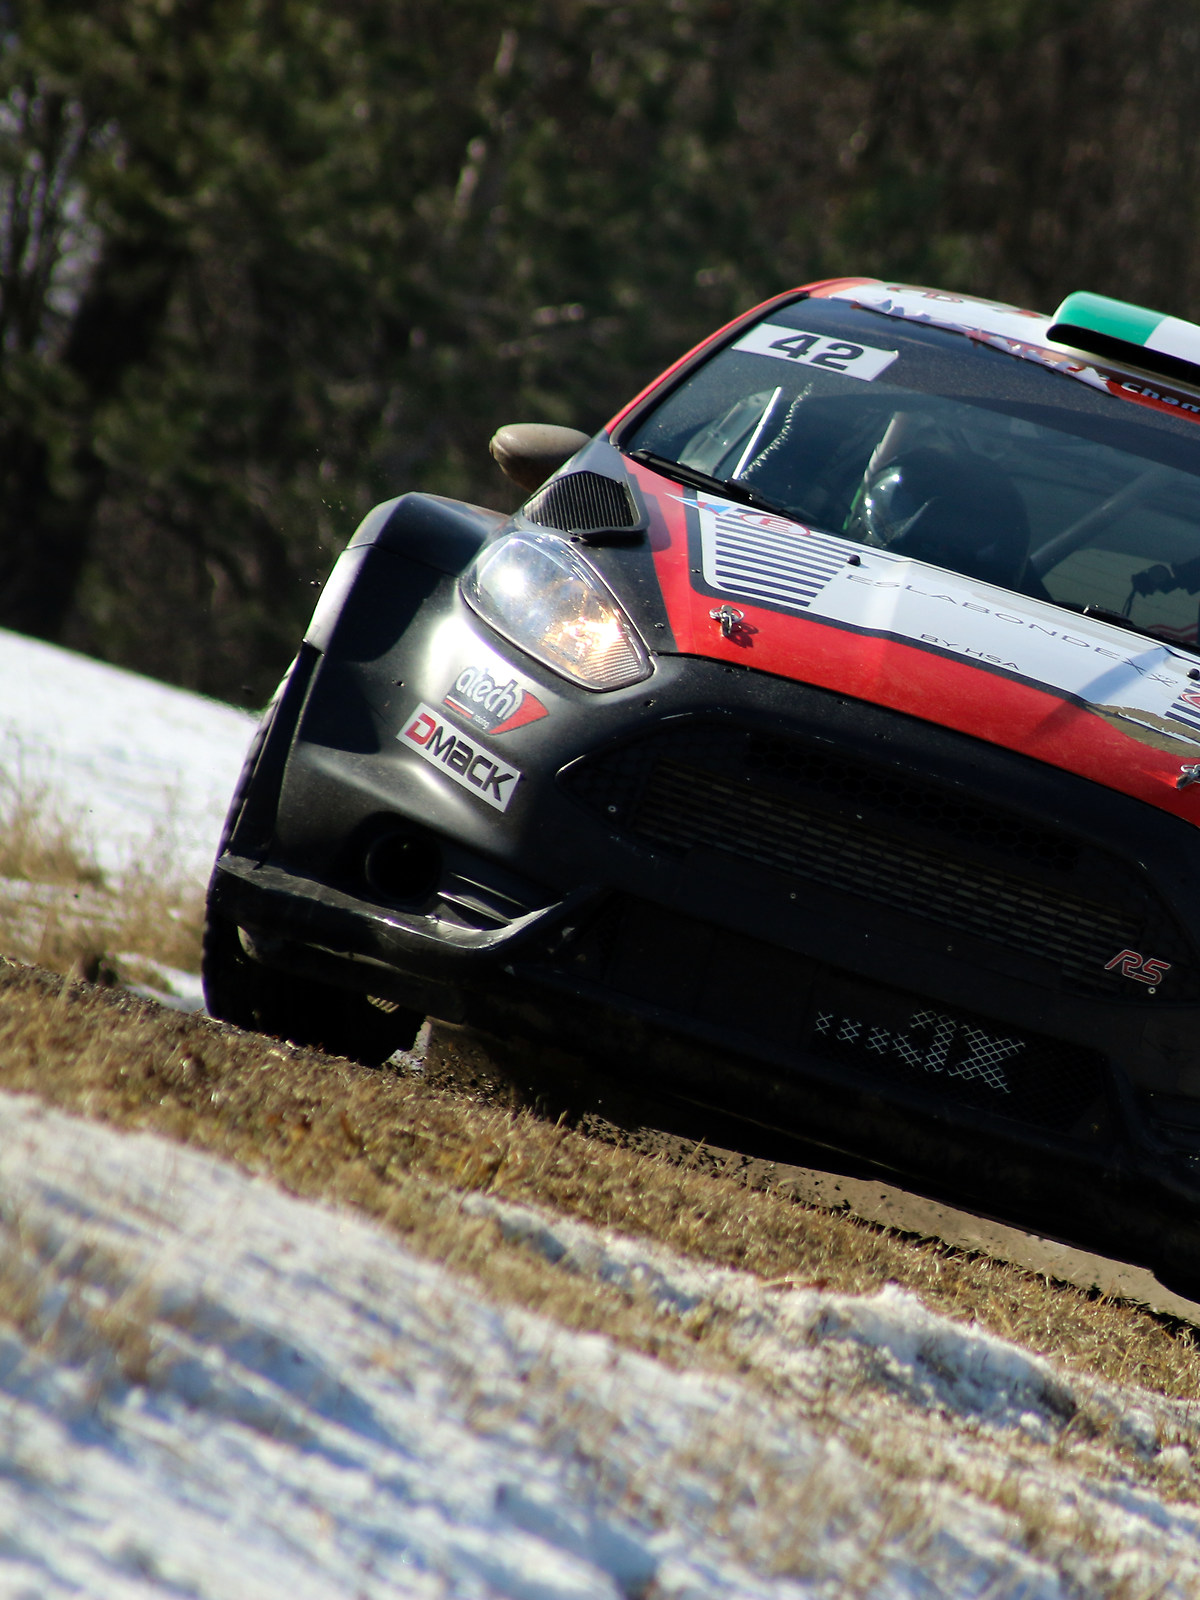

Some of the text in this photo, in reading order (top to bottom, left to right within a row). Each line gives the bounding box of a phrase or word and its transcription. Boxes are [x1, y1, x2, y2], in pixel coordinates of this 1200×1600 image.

[767, 333, 865, 371] 42
[920, 633, 1020, 671] BY HSA
[455, 667, 518, 720] atech
